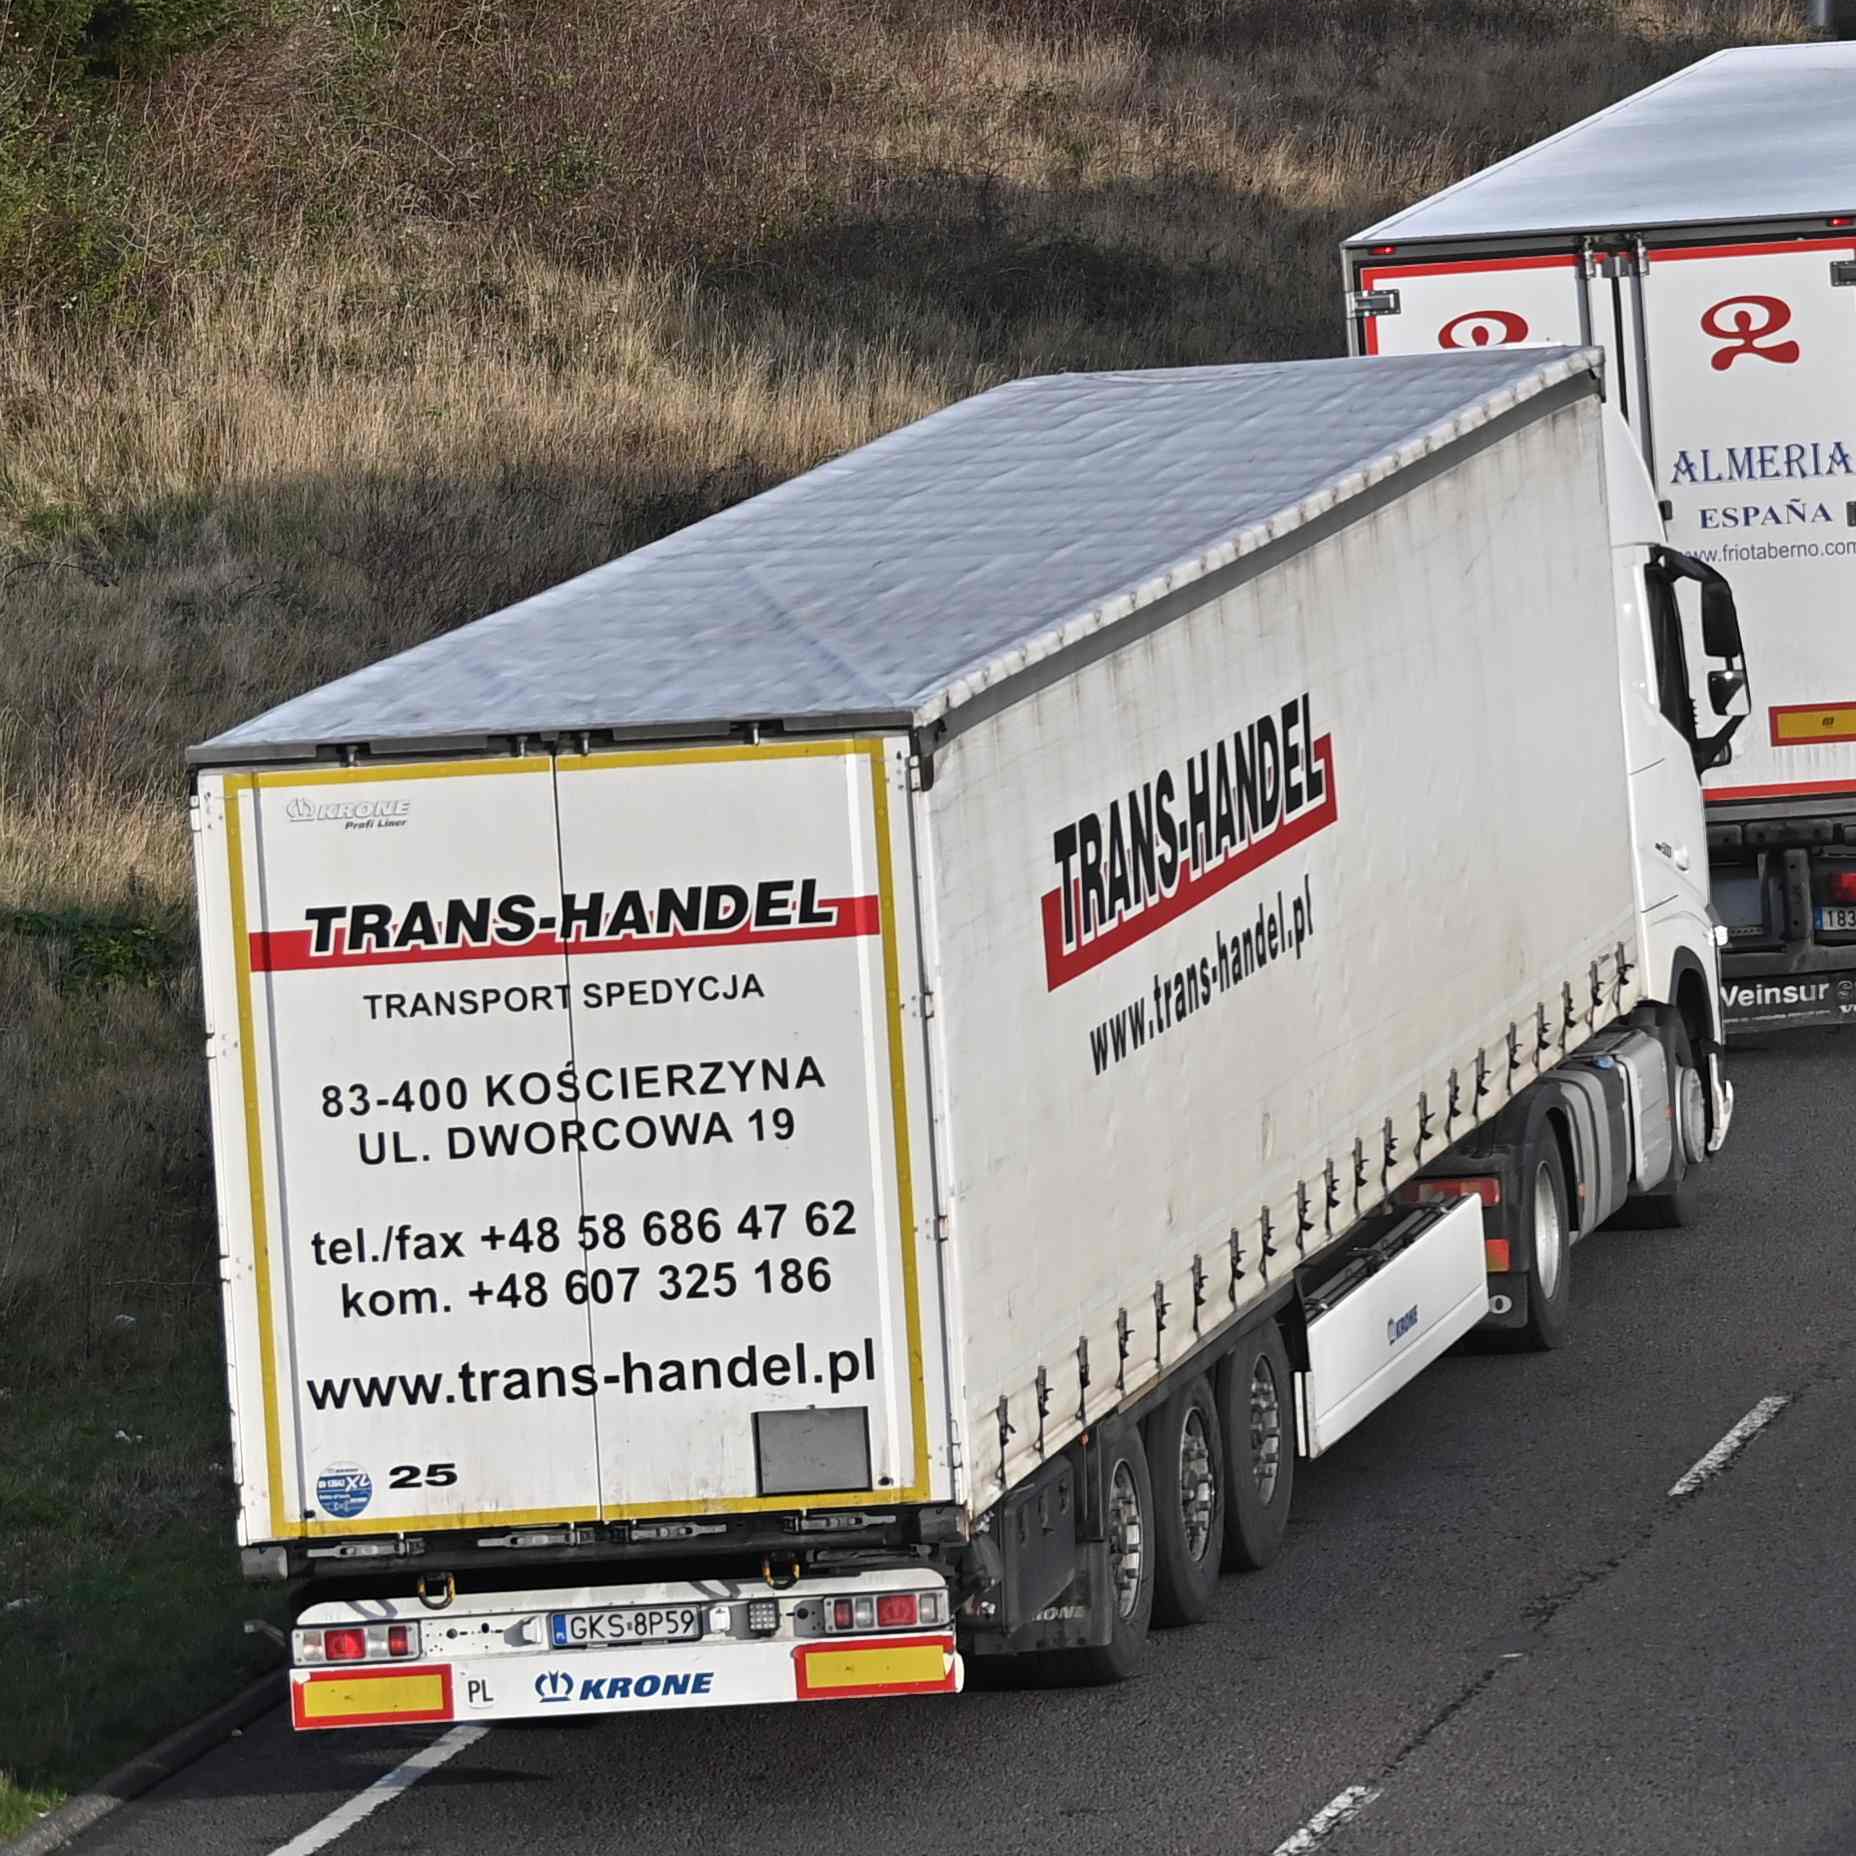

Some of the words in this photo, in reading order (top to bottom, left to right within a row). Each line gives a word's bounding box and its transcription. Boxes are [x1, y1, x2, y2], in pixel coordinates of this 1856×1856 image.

[1670, 441, 1855, 483] ALMERIA
[1699, 498, 1832, 529] ESPAÑA
[317, 800, 410, 820] KRONE
[345, 819, 375, 829] Profi
[377, 819, 407, 828] Liner
[1053, 692, 1323, 945] TRANS-HANDEL
[305, 878, 838, 954] TRANS-HANDEL
[1090, 873, 1313, 1076] www.trans-handel.pl
[1720, 982, 1830, 1007] Veinsur
[363, 985, 570, 1020] TRANSPORT
[583, 974, 765, 1009] SPEDYCJA
[322, 1076, 468, 1118] 83-400
[486, 1055, 825, 1107] KOŚCIERZYNA
[359, 1130, 430, 1165] UL.
[447, 1110, 731, 1158] DWORCOWA
[749, 1108, 796, 1142] 19
[311, 1225, 465, 1265] tel./fax
[480, 1217, 560, 1254] +48
[578, 1214, 625, 1251] 58
[642, 1207, 722, 1246] 686
[737, 1204, 787, 1241] 47
[805, 1200, 857, 1237] 62
[341, 1282, 452, 1318] kom.
[468, 1272, 548, 1308] +48
[565, 1267, 642, 1304] 607
[658, 1260, 737, 1299] 325
[755, 1256, 832, 1294] 186
[306, 1338, 876, 1410] www.trans-handel.pl
[389, 1463, 458, 1489] 25
[570, 1614, 625, 1640] GKS
[634, 1610, 695, 1636] 8P59
[467, 1679, 494, 1703] PL
[579, 1672, 714, 1701] KRONE
